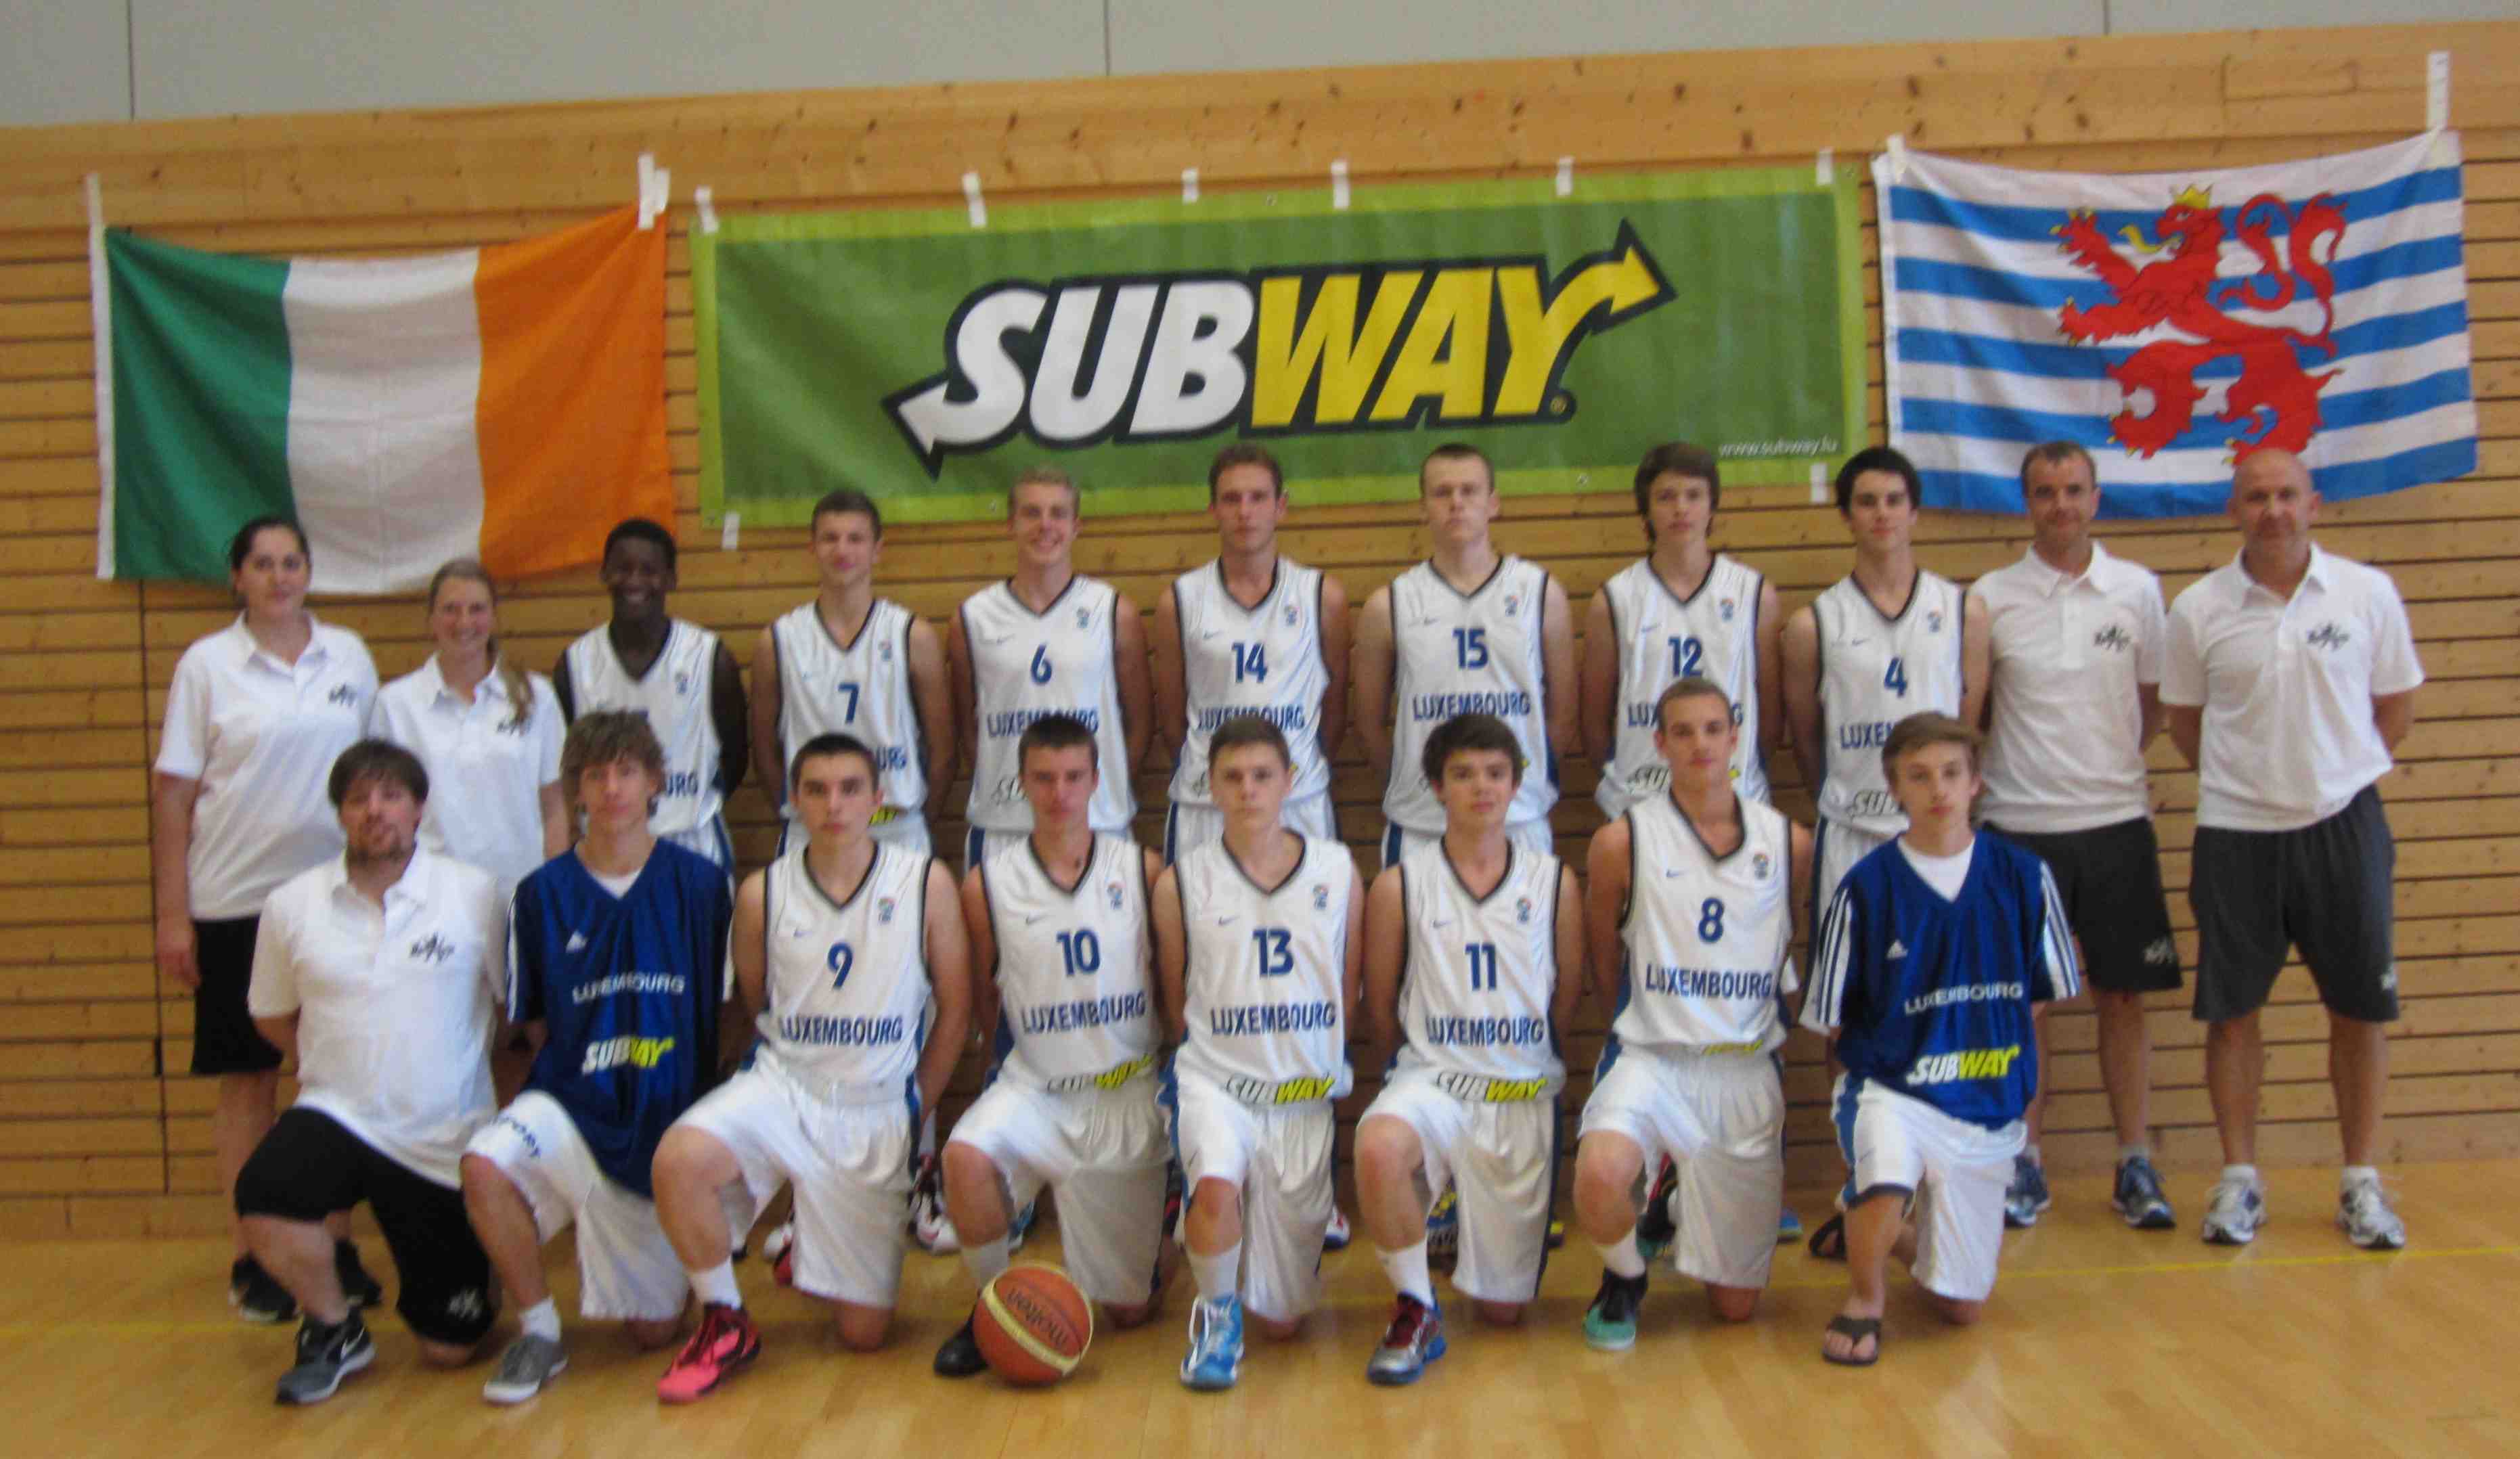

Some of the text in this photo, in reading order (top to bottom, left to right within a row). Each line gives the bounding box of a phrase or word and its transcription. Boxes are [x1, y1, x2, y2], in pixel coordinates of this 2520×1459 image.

[898, 233, 1665, 455] SUBWAY
[1719, 434, 1839, 457] www.subway.lu
[1031, 645, 1052, 684] 6
[1232, 643, 1267, 683] 14
[1453, 628, 1488, 669] 15
[1668, 636, 1702, 676] 12
[1884, 658, 1907, 697] 4
[838, 683, 860, 725] 7
[1413, 692, 1531, 721] LUXEMBOURG
[1698, 897, 1725, 944] 8
[827, 942, 854, 990] 9
[1056, 928, 1101, 977] 10
[1252, 928, 1294, 977] 13
[1465, 943, 1497, 991] 11
[1645, 964, 1773, 1000] LUXEMBOURG
[1904, 982, 2024, 1015] LUXEMBOURG
[780, 1016, 904, 1046] LUXEMBOURG
[1021, 991, 1147, 1035] LUXEMBOURG
[1211, 1000, 1336, 1035] LUXEMBOURG
[1425, 1015, 1544, 1047] LUXEMBOURG
[1906, 1046, 2020, 1086] SUBWAY
